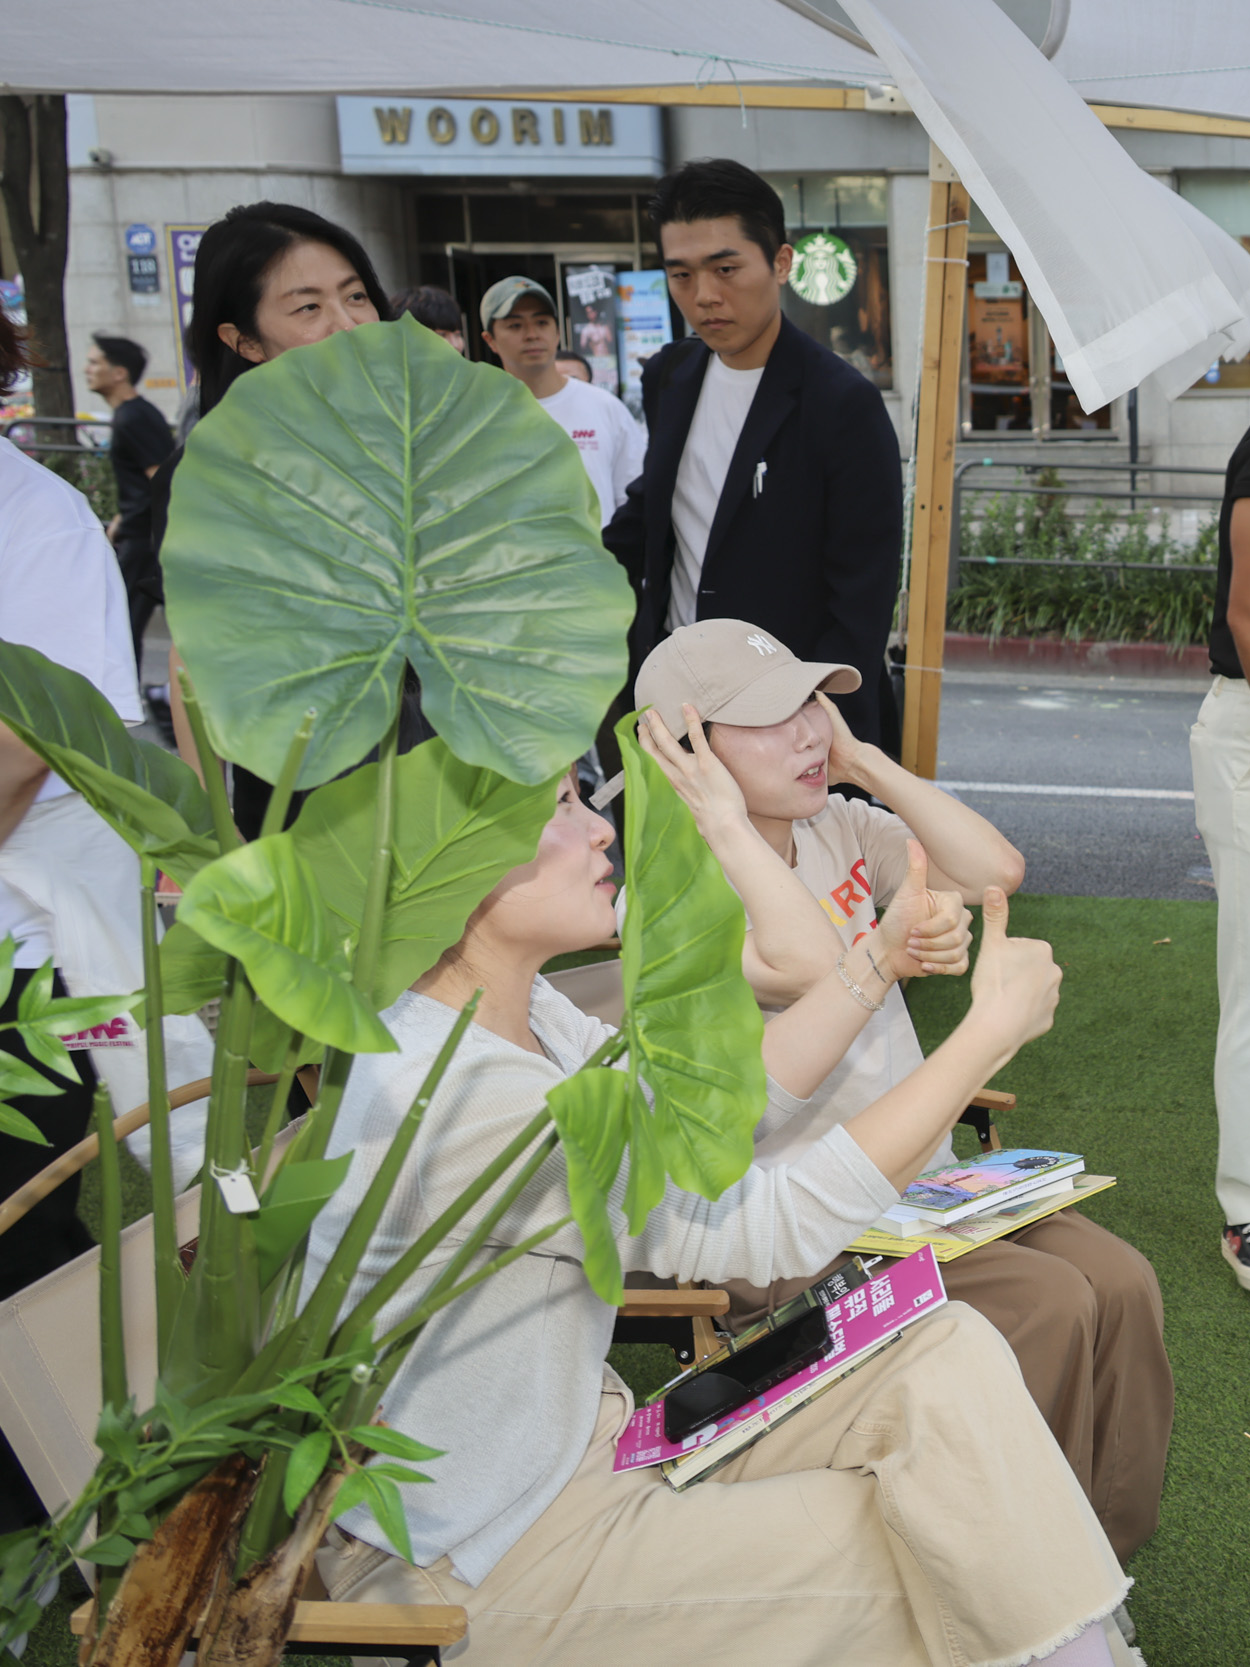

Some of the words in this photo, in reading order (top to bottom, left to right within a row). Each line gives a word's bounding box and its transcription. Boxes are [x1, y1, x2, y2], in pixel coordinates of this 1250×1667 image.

[374, 107, 614, 145] WOORIM
[827, 1273, 851, 1300] 행복의
[869, 1274, 896, 1318] 서리풀
[843, 1288, 869, 1323] 뮤직
